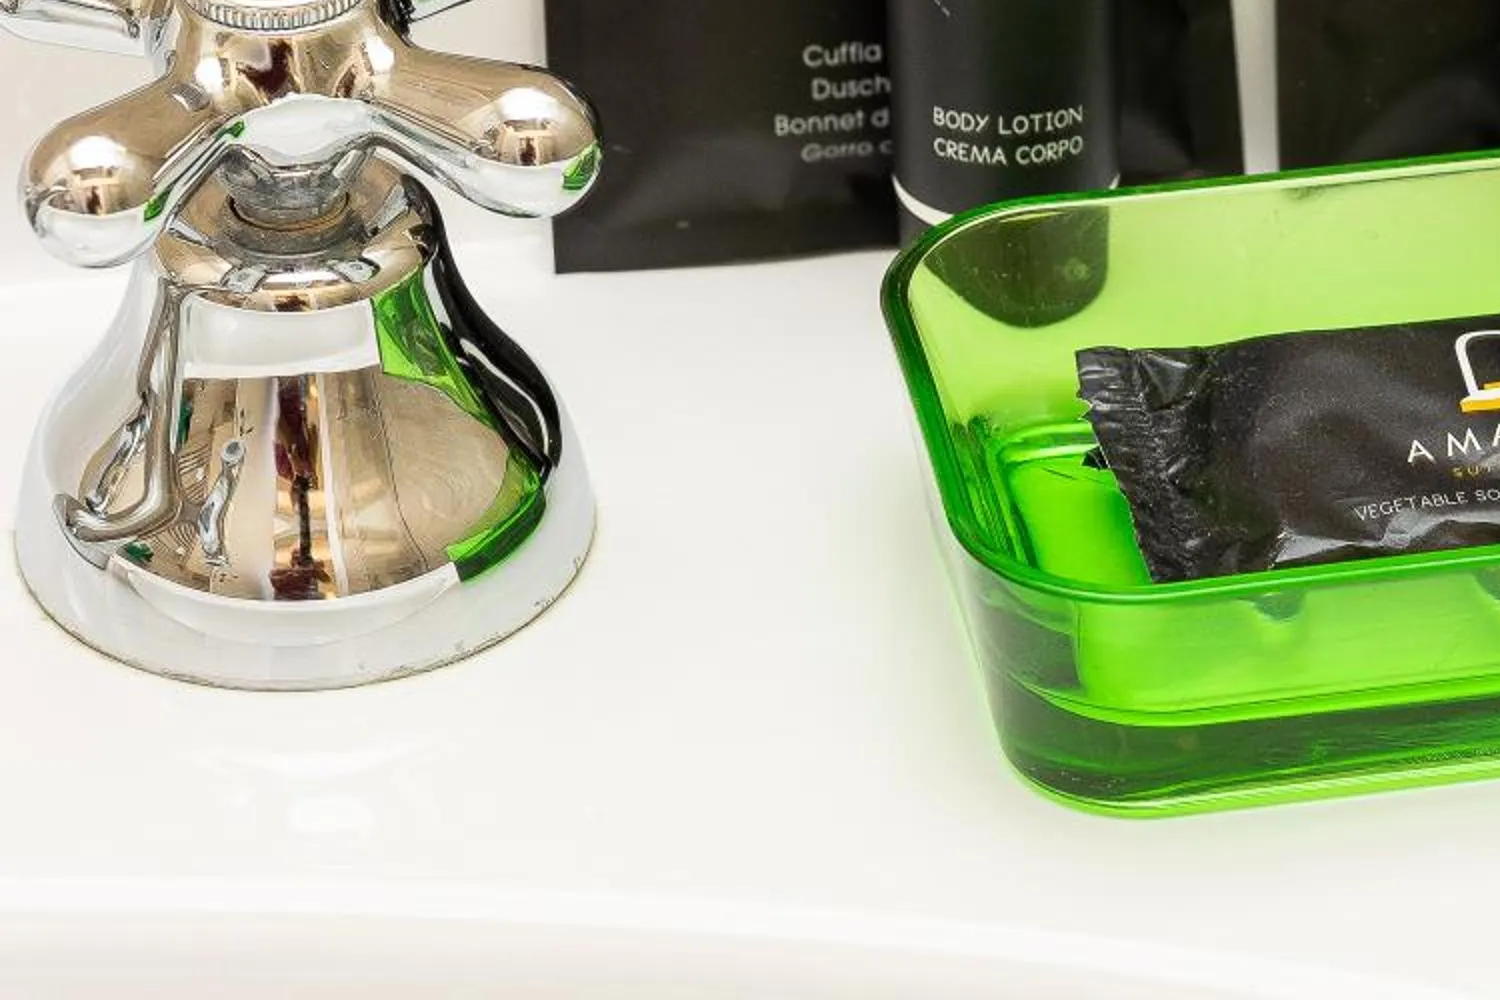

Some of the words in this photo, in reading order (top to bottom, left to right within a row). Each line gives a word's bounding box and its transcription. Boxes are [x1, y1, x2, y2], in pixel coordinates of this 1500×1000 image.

[932, 106, 990, 133] BODY
[998, 104, 1085, 136] LOTION
[932, 136, 1008, 166] CREMA
[1014, 134, 1085, 166] CORPO
[1353, 490, 1467, 522] VEGETABLE
